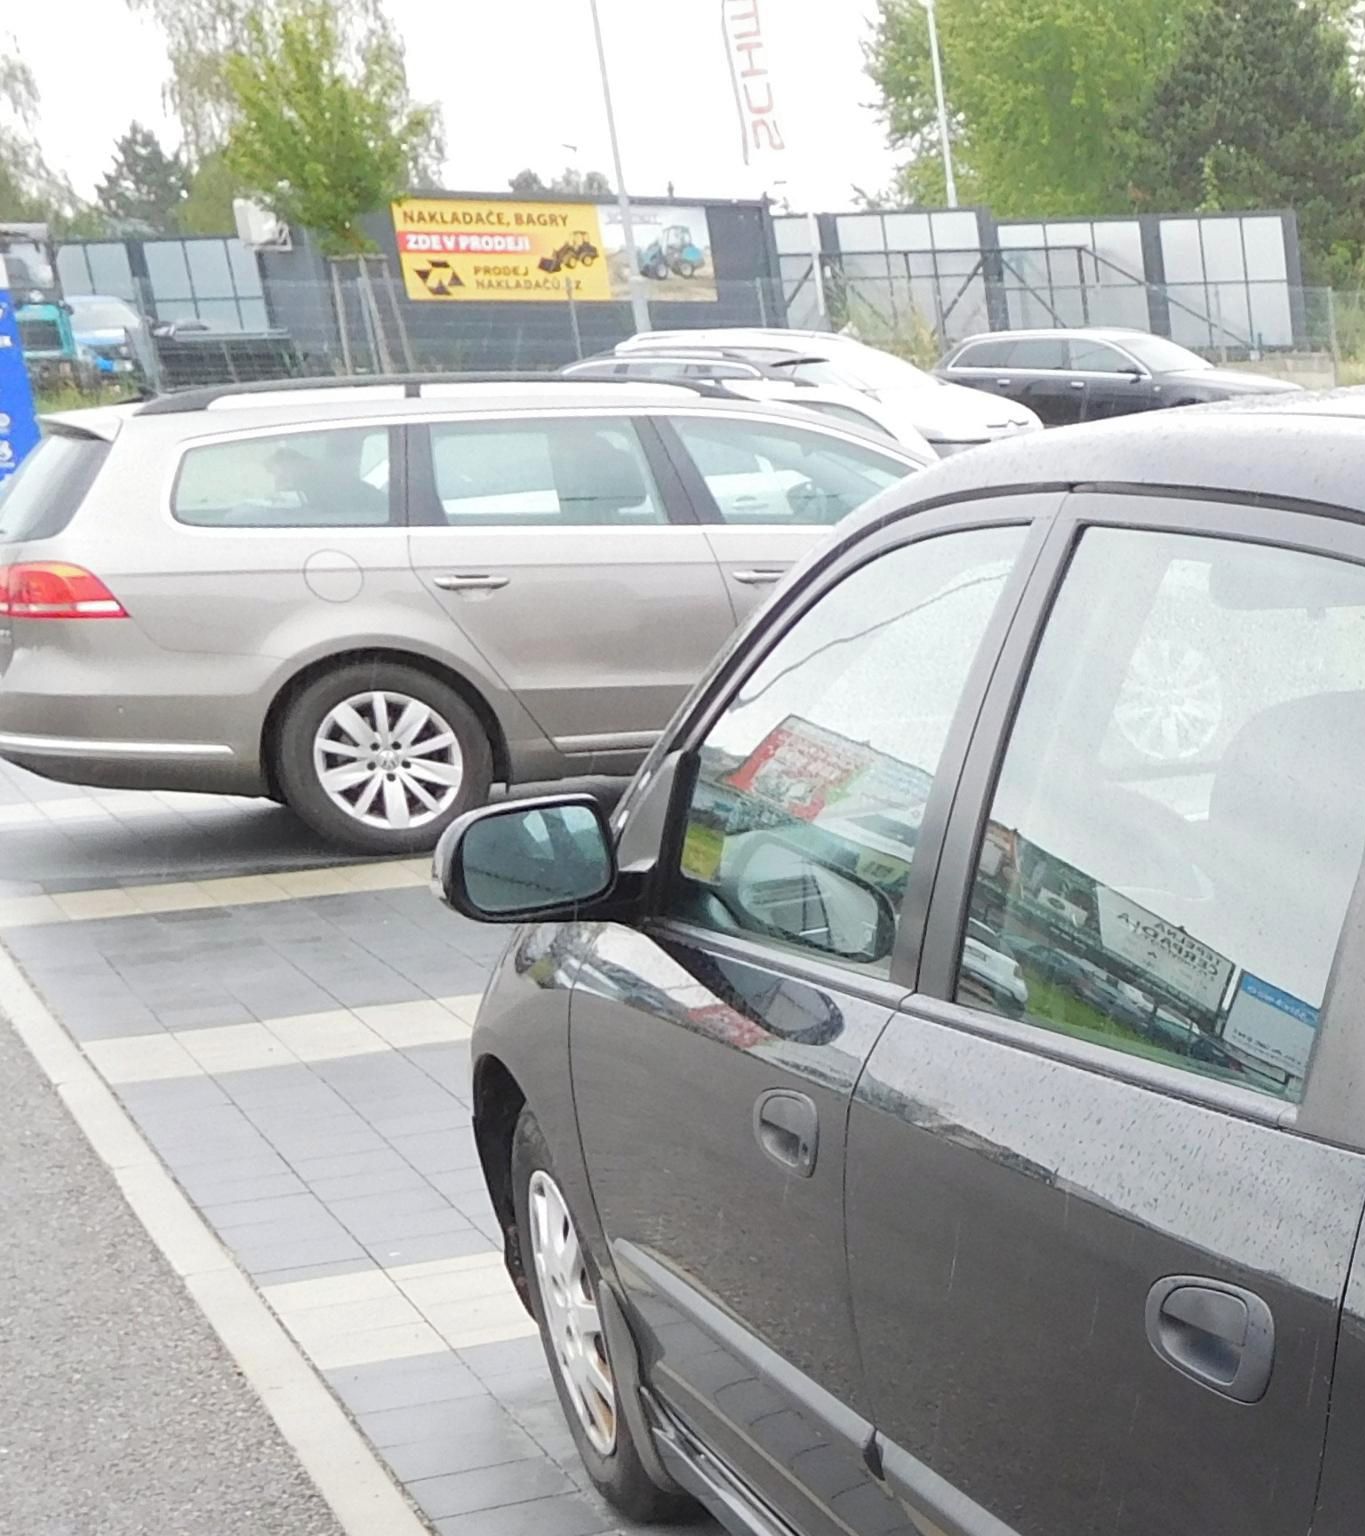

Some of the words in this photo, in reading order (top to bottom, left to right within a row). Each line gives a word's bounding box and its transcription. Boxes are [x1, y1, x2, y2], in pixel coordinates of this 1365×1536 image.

[402, 208, 511, 227] NAKLADAČE,
[514, 211, 569, 228] BAGRY
[405, 233, 441, 250] ZDE
[442, 234, 456, 250] V
[473, 265, 529, 279] PRODEJ
